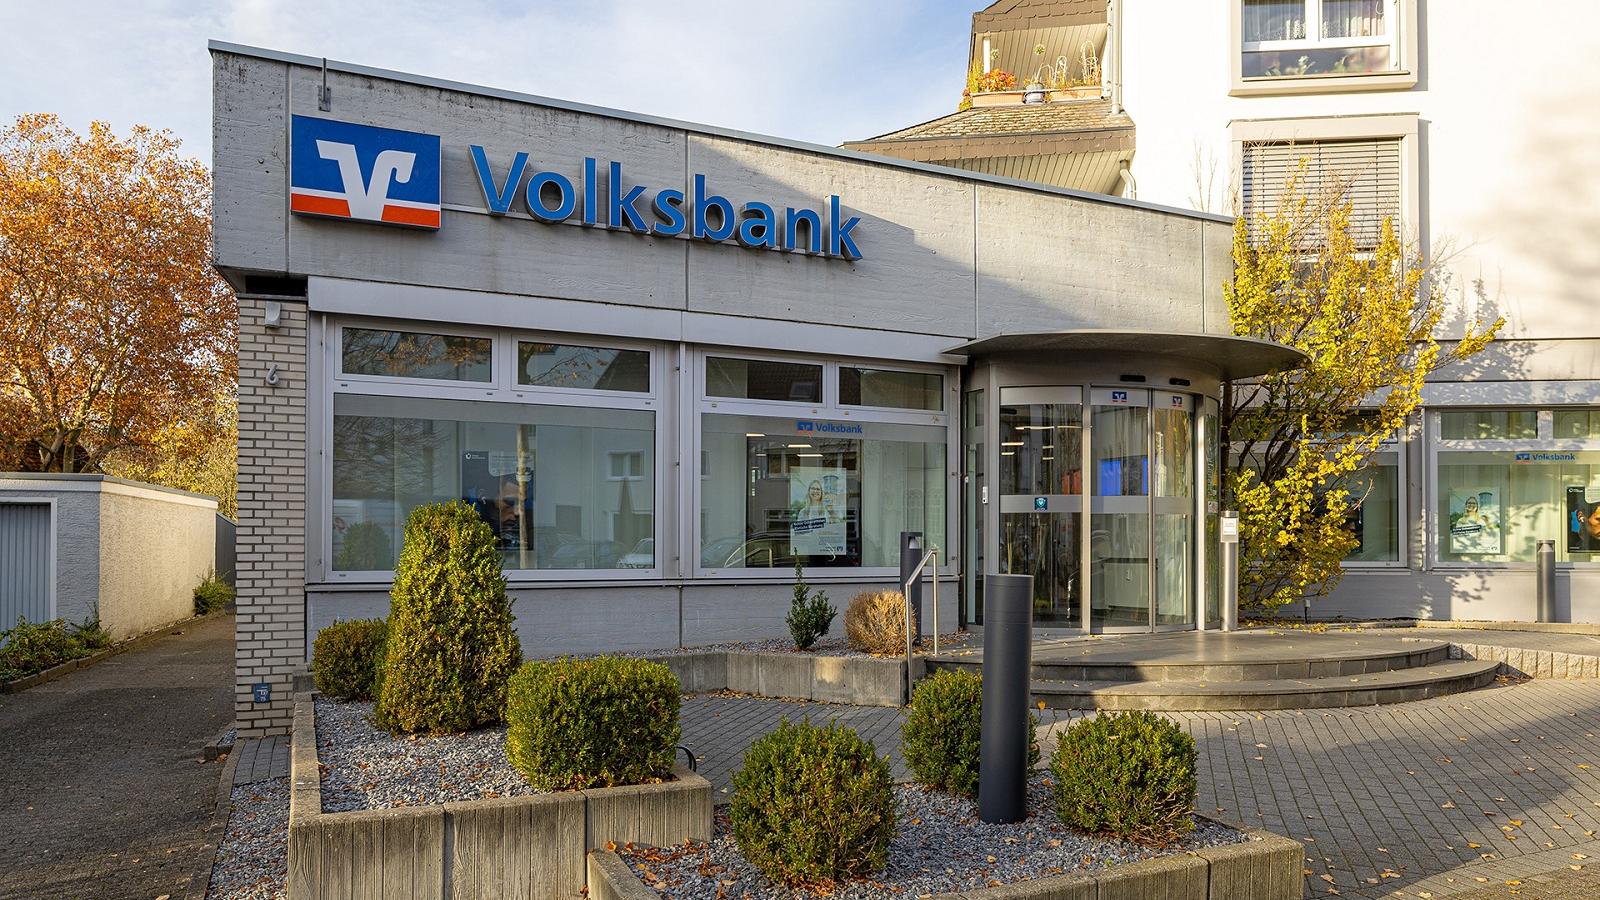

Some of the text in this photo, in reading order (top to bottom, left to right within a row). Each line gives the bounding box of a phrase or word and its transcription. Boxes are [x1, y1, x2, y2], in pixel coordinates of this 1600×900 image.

[468, 144, 863, 261] Volksbank
[266, 363, 279, 385] 6
[815, 422, 863, 434] Volksbank
[1532, 453, 1576, 461] Volksbank
